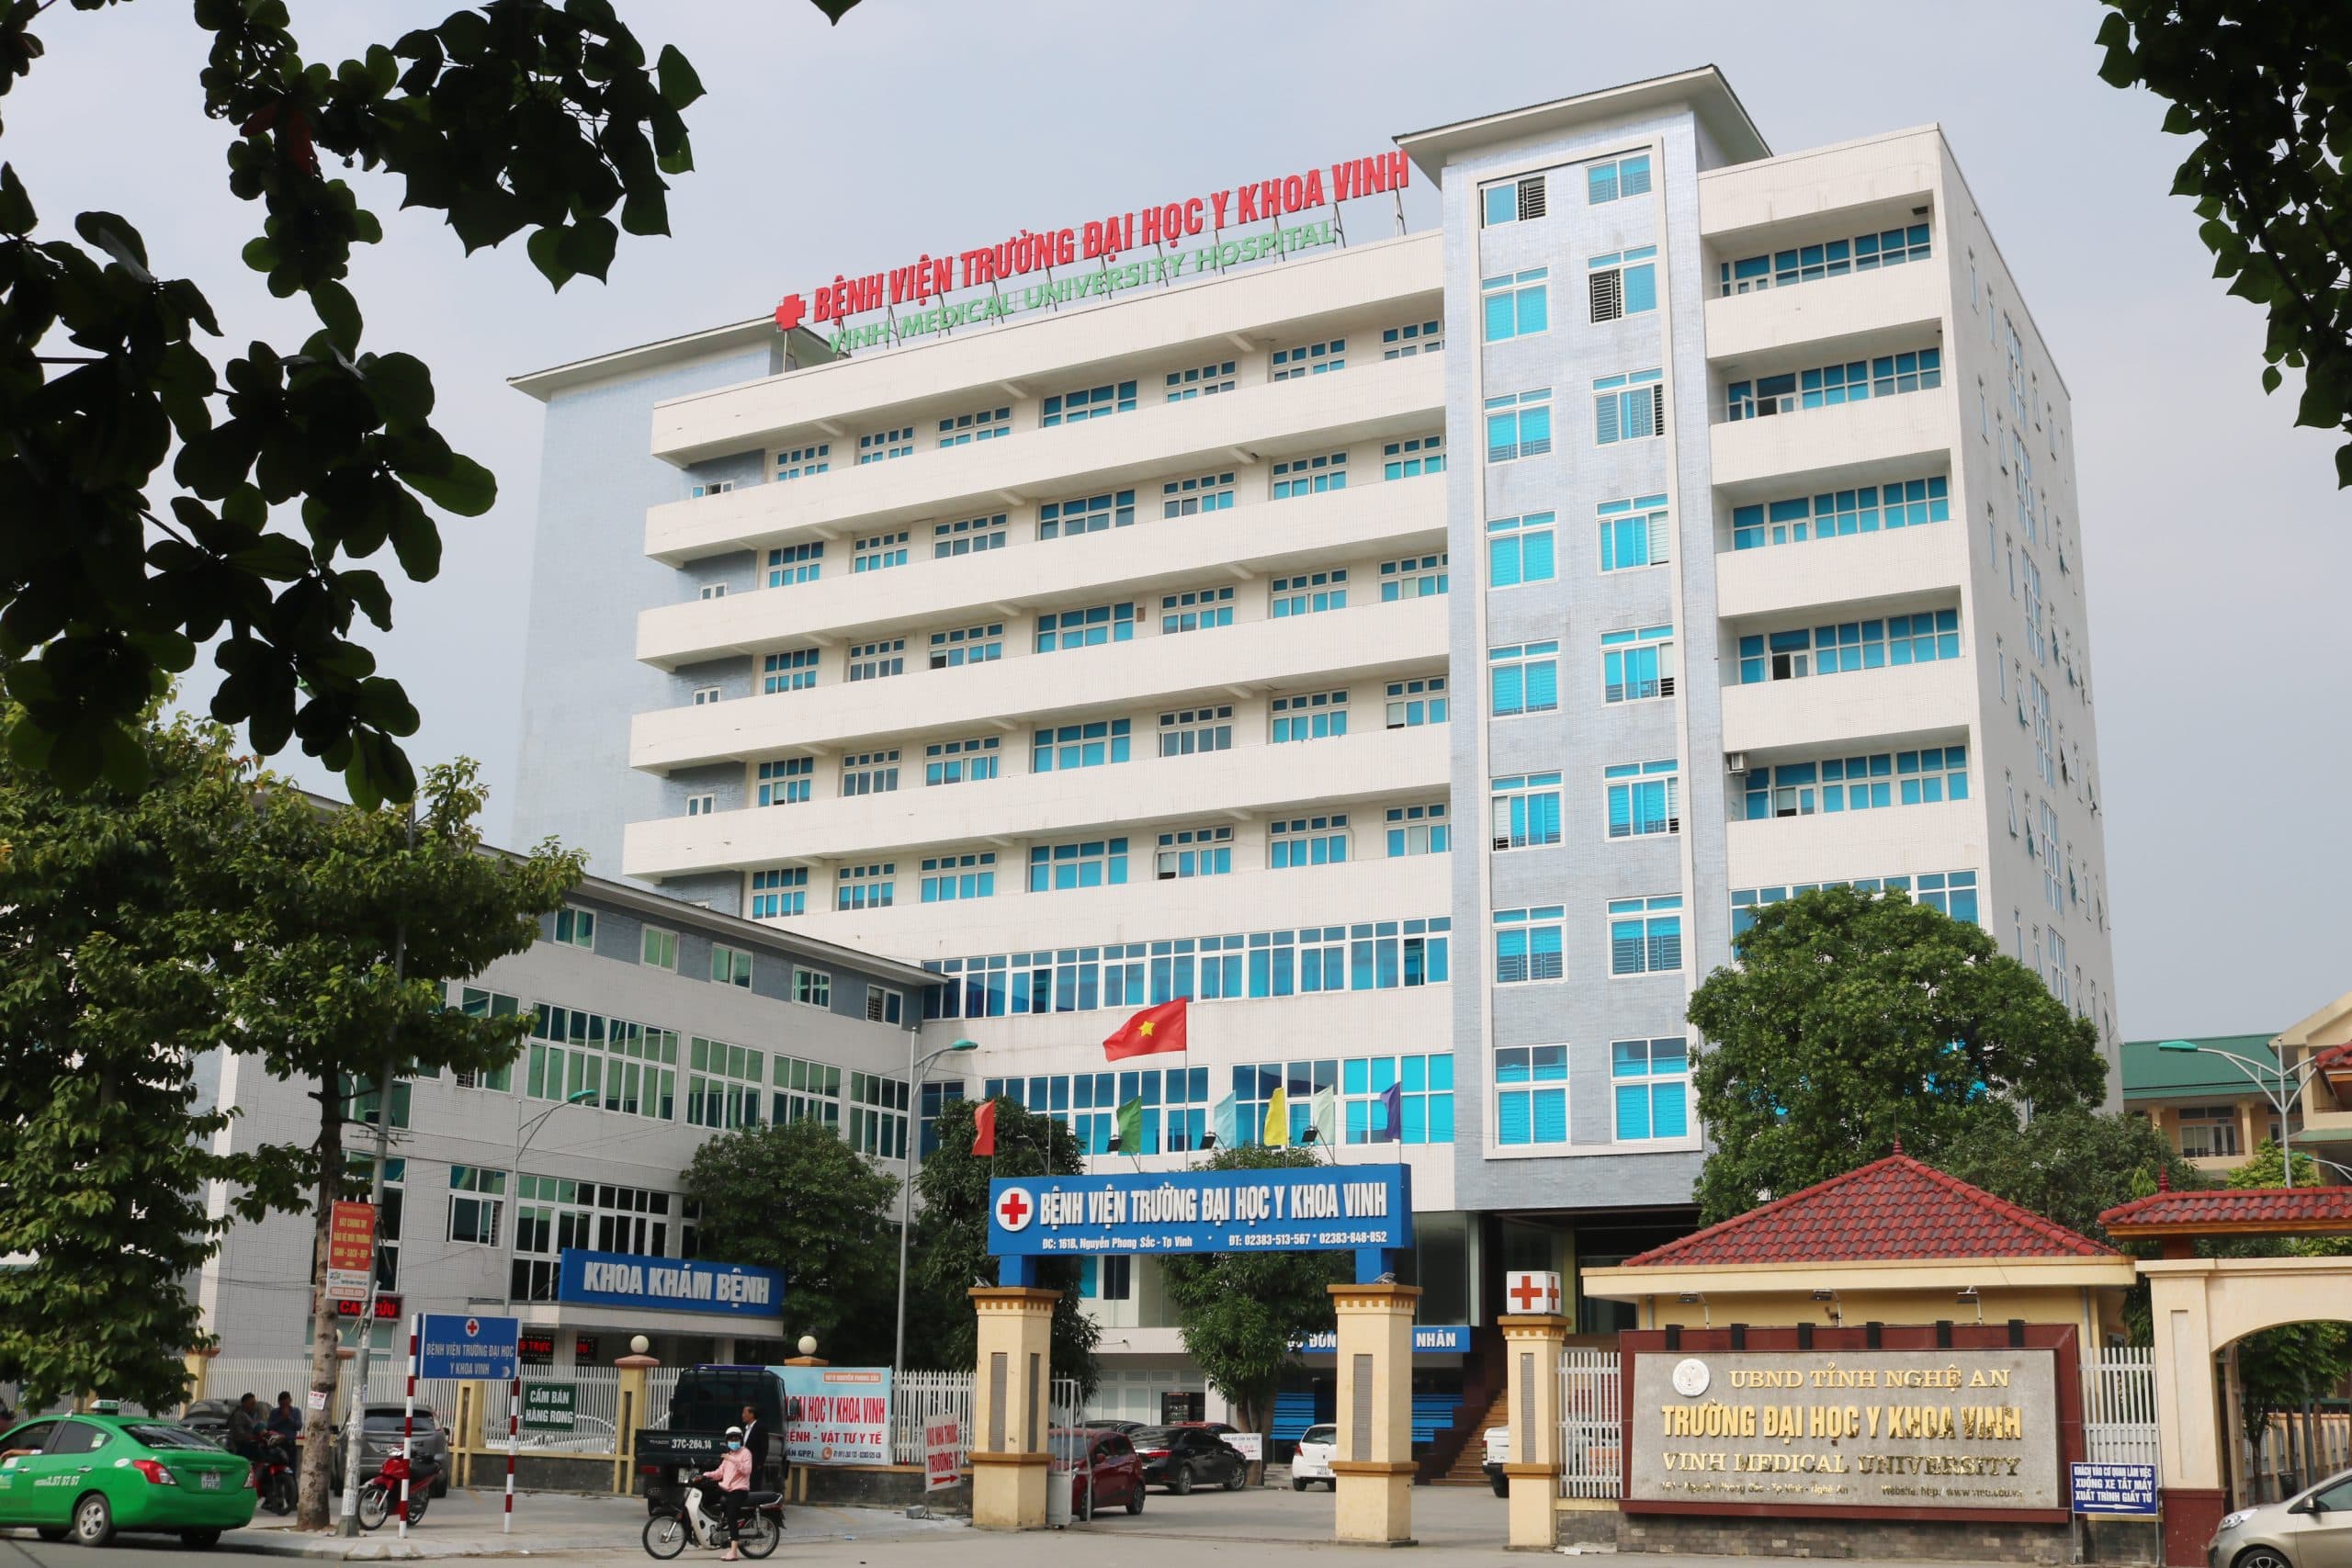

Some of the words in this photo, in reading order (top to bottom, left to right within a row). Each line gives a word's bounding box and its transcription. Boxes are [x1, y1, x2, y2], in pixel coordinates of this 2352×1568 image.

[814, 273, 884, 326] BỆNH
[889, 254, 953, 306] VIỆN
[960, 228, 1075, 288] TRƯỜNG
[1082, 211, 1133, 262] ĐẠI
[1142, 197, 1203, 249] HỌC
[1211, 190, 1229, 230] Y
[1238, 168, 1326, 225] KHOA
[1331, 150, 1409, 202] VINH
[827, 323, 889, 355] VINH
[899, 294, 1014, 339] MEDICAL
[1023, 253, 1186, 310] UNIVERSITY
[1193, 220, 1337, 272] HOSPITAL
[1040, 1185, 1083, 1231] BỆNH
[1088, 1183, 1126, 1230] VIỆN
[1131, 1181, 1196, 1223] TRƯỜNG
[1202, 1187, 1231, 1226] ĐẠI
[1235, 1186, 1271, 1226] HỌC
[1274, 1185, 1285, 1219] Y
[1291, 1184, 1340, 1219] KHOA
[1343, 1182, 1387, 1217] VINH
[1112, 1237, 1136, 1250] Phong
[1140, 1235, 1155, 1248] Sắc
[1162, 1237, 1171, 1248] Tp
[1175, 1236, 1193, 1247] Vinh
[1228, 1235, 1242, 1247] ĐT:
[583, 1261, 643, 1295] KHOA
[648, 1263, 712, 1300] KHÁM
[716, 1268, 770, 1308] BỆNH
[1416, 1329, 1456, 1348] NHÂN
[426, 1341, 445, 1359] BỆNH
[446, 1342, 461, 1359] VIỆN
[463, 1340, 487, 1358] TRƯỜNG
[489, 1344, 500, 1359] ĐẠI
[501, 1344, 514, 1360] HỌC
[449, 1363, 455, 1375] Y
[456, 1363, 473, 1375] KHOA
[474, 1363, 491, 1375] VINH
[1729, 1371, 1804, 1388] UBND
[1810, 1361, 1878, 1389] TỈNH
[1884, 1363, 1962, 1393] NGHỆ
[1968, 1370, 2011, 1388] AN
[530, 1387, 549, 1404] CẤM
[551, 1388, 570, 1404] BÁN
[526, 1408, 548, 1423] HÀNG
[550, 1410, 573, 1424] RONG
[808, 1396, 826, 1428] HỌC
[829, 1397, 834, 1423] Y
[836, 1397, 860, 1424] KHOA
[863, 1397, 885, 1424] VINH
[1661, 1398, 1756, 1438] TRƯỜNG
[1762, 1405, 1804, 1445] ĐẠI
[1810, 1405, 1860, 1446] HỌC
[1866, 1406, 1882, 1438] Y
[1888, 1405, 1956, 1439] KHOA
[1961, 1406, 2022, 1440] VINH
[821, 1429, 840, 1446] VẬT
[843, 1432, 857, 1444] TƯ
[860, 1433, 865, 1444] Y
[869, 1429, 882, 1445] TẾ
[928, 1449, 953, 1473] TRƯỜNG
[955, 1450, 958, 1470] Y
[1662, 1452, 1726, 1472] VINH
[1734, 1453, 1849, 1473] MEDICAL
[1858, 1455, 2022, 1476] UNIVERSITY
[2075, 1476, 2103, 1488] XUỐNG
[2105, 1480, 2116, 1489] XE
[2133, 1478, 2152, 1490] MÁY
[2097, 1490, 2120, 1502] TRÌNH
[2142, 1491, 2152, 1504] TỜ
